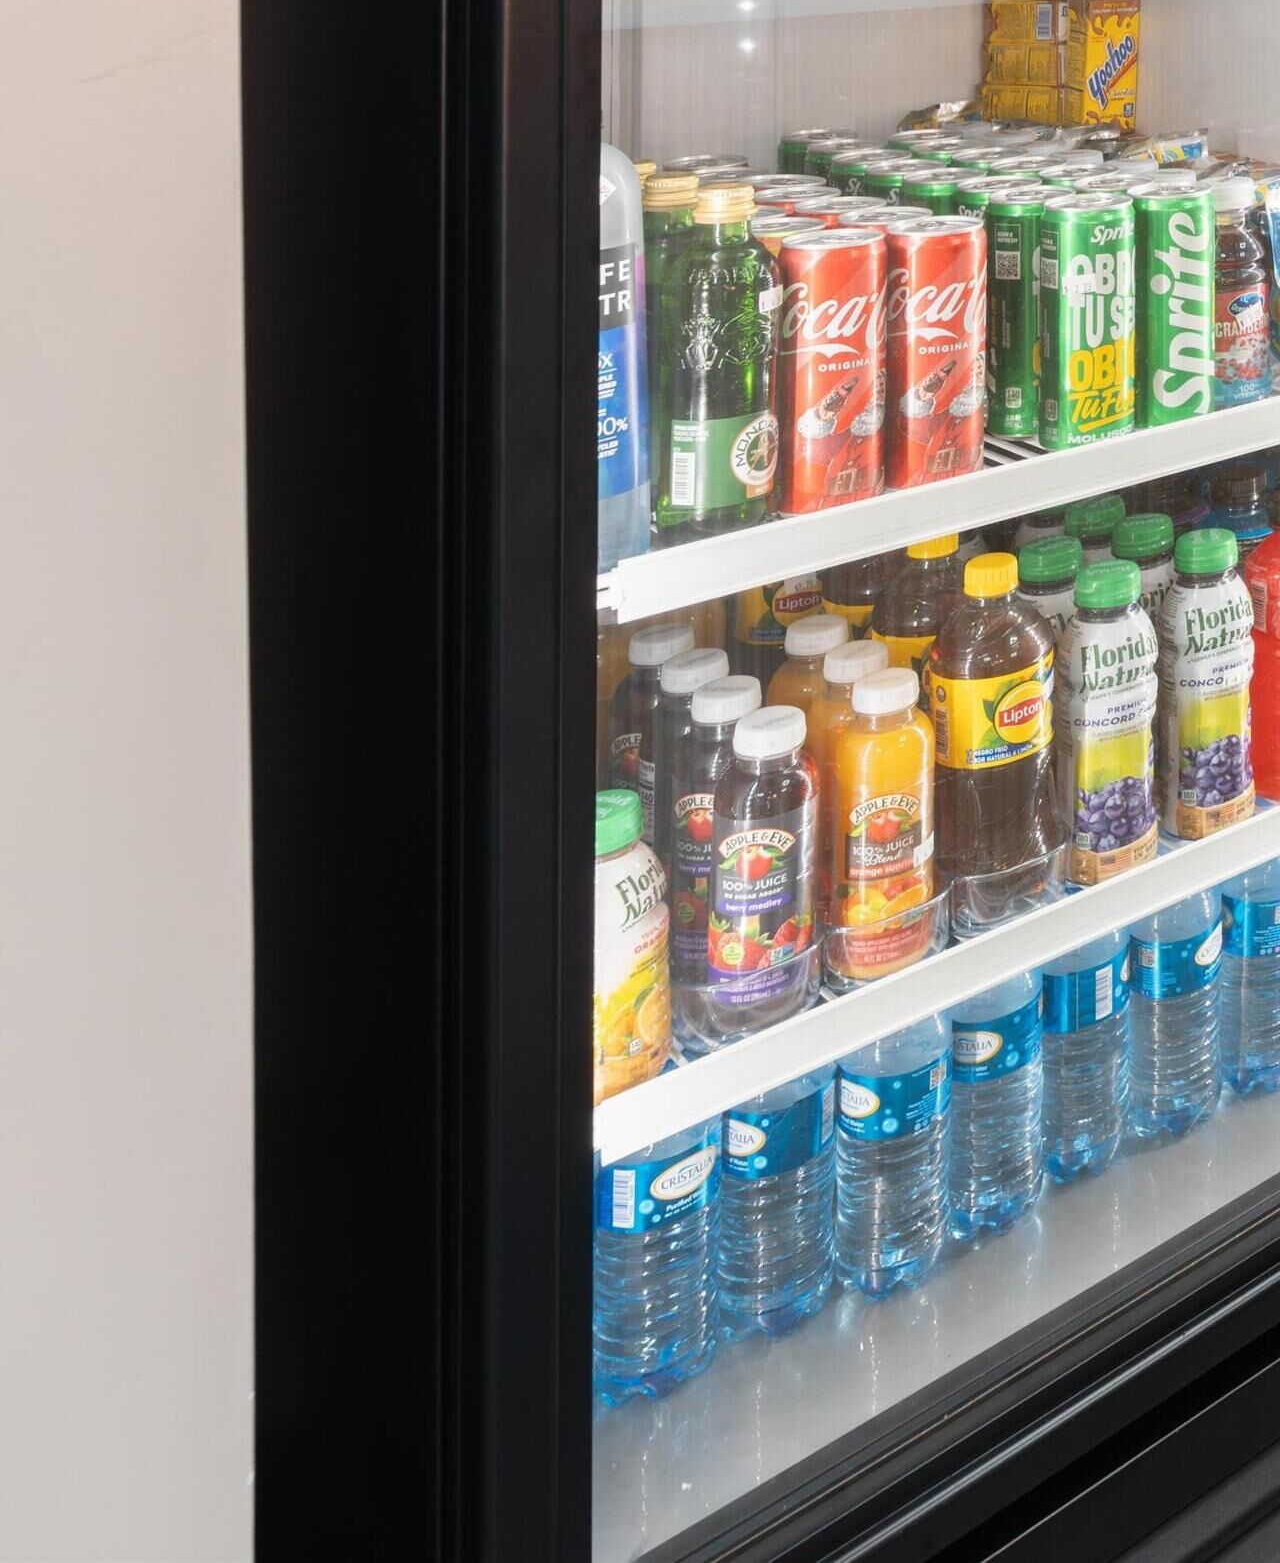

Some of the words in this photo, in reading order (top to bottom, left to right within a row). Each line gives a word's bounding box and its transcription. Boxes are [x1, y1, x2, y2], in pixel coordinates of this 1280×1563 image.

[1067, 294, 1104, 350] TU
[1150, 212, 1215, 415] Sprite
[918, 339, 973, 355] ORIGINAL
[818, 356, 874, 373] ORIGINAL
[778, 593, 820, 610] Lipton
[1180, 677, 1224, 688] CONCO
[1003, 700, 1042, 724] Lipton
[1074, 712, 1136, 728] CONCORD
[986, 752, 1011, 763] NATURAL
[679, 796, 706, 815] APPLE
[855, 796, 890, 823] APPLE
[890, 796, 898, 806] &
[898, 794, 918, 813] EVE
[724, 831, 759, 856] APPLE
[761, 830, 769, 841] &
[769, 831, 793, 850] EVE
[853, 845, 884, 857] 100%
[885, 835, 915, 853] JUICE
[864, 849, 904, 868] Blend
[850, 865, 883, 878] orange
[722, 879, 753, 892] 100%
[754, 873, 788, 891] JUICE
[725, 901, 746, 913] berry
[749, 898, 783, 911] medley
[734, 892, 757, 900] SUGAR
[661, 1156, 713, 1190] CRISTALIA
[666, 1194, 693, 1213] Purified
